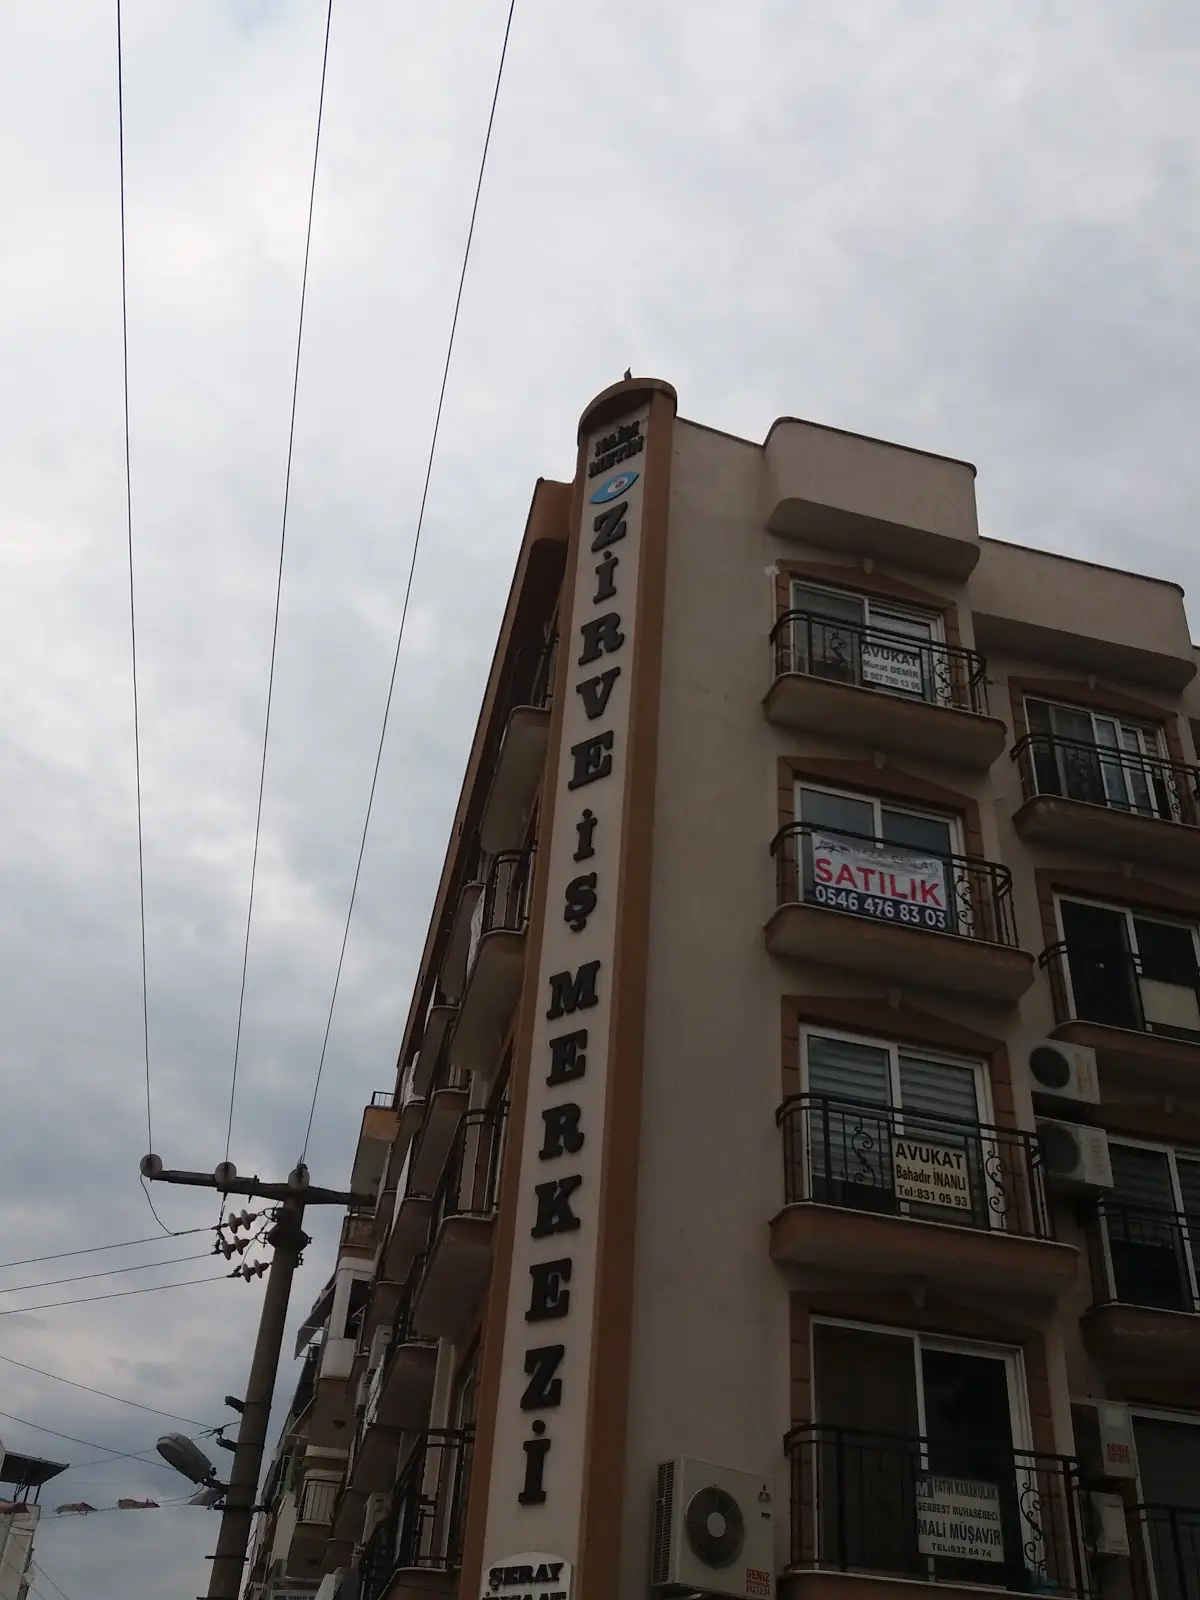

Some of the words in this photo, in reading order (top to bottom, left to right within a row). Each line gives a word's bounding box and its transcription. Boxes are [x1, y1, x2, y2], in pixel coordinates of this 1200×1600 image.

[567, 501, 629, 790] ZİRVE
[863, 646, 918, 667] AVUKAT
[564, 808, 598, 932] İŞ
[815, 858, 943, 907] SATILIK
[815, 885, 860, 911] 0546
[863, 897, 895, 918] 476
[899, 904, 920, 923] 83
[925, 909, 946, 929] 03
[895, 1142, 963, 1170] AVUKAT
[896, 1164, 931, 1185] Bahadır
[932, 1167, 966, 1191] İNANLI
[897, 1184, 935, 1201] Tel:831
[939, 1192, 952, 1204] 05
[954, 1195, 967, 1207] 93
[517, 960, 601, 1506] MERKEZİ
[917, 1501, 951, 1516] SERBEST
[918, 1519, 946, 1538] MALİ
[949, 1521, 1002, 1546] MÜŞAVİR
[488, 1562, 564, 1591] ŞERAY
